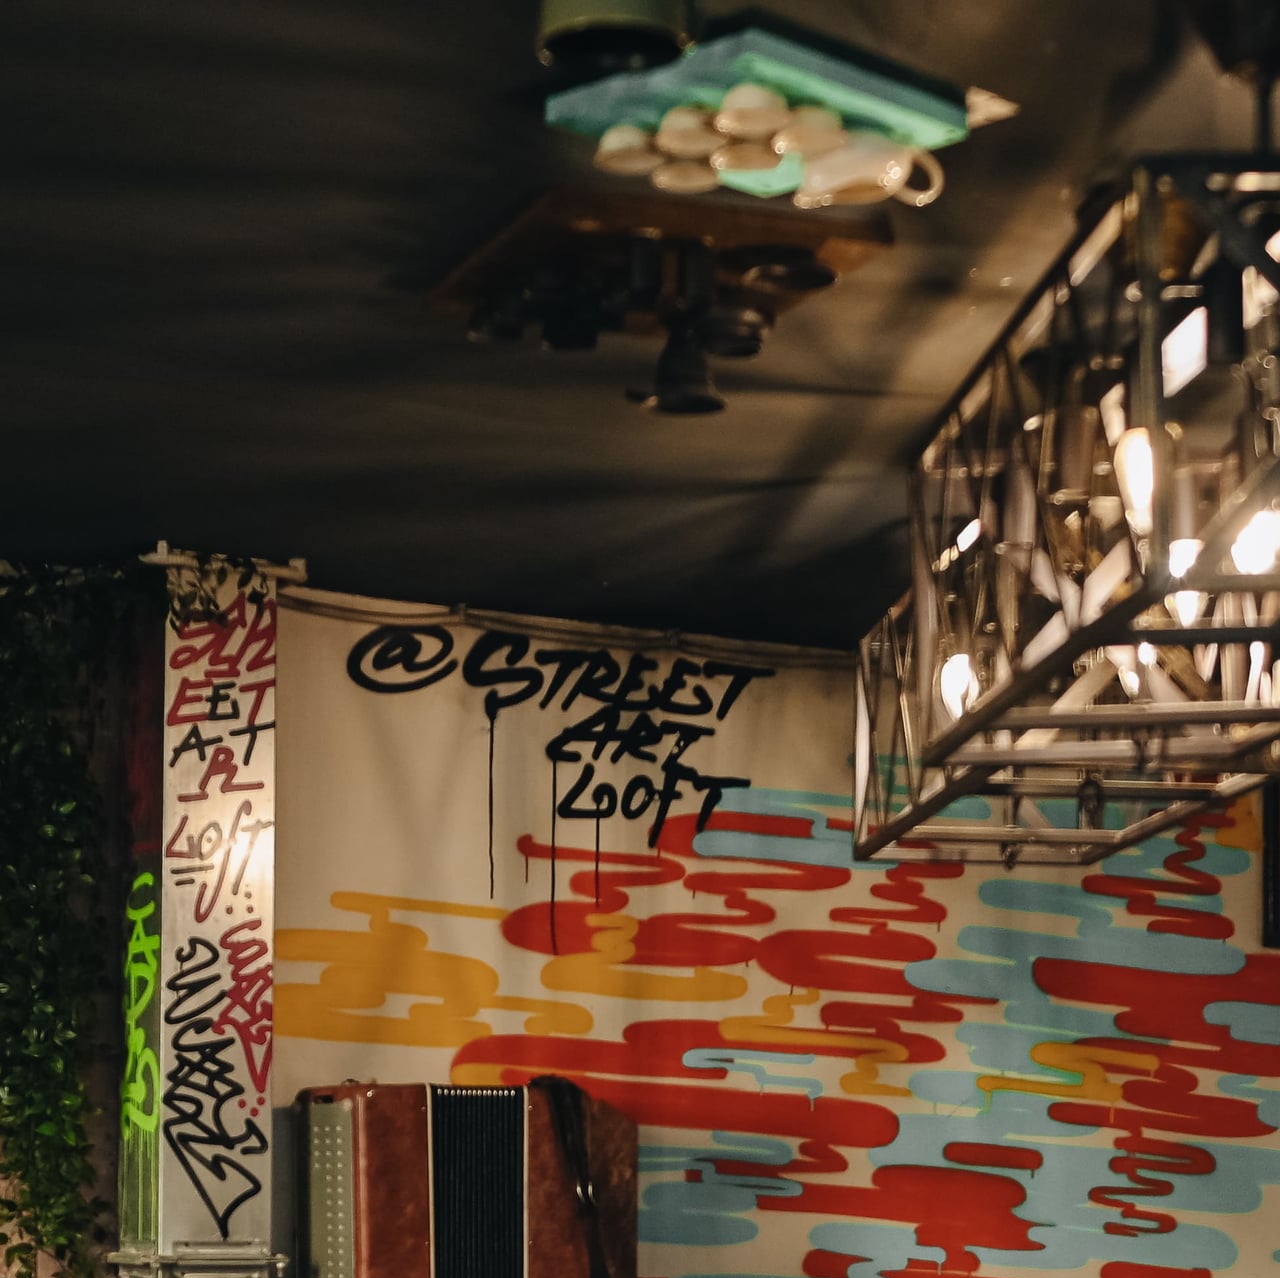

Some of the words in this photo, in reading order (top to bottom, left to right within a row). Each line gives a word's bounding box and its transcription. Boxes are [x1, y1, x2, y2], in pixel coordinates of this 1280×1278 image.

[346, 625, 776, 720] @STREET
[546, 704, 716, 770] ART
[557, 763, 751, 848] LOFT
